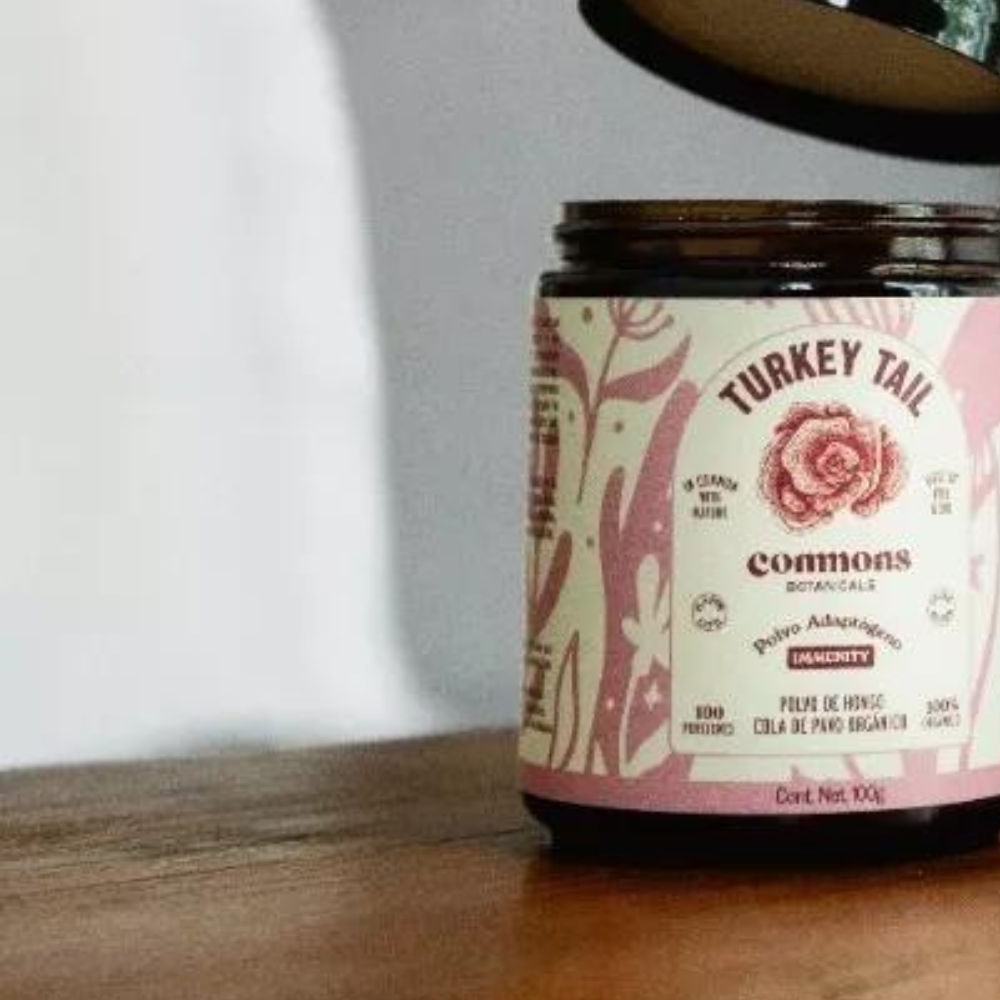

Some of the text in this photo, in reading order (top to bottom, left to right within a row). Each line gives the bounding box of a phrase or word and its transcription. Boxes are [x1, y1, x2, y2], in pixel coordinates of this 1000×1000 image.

[718, 339, 933, 418] TURKEY TAIL
[747, 549, 912, 577] commons
[786, 579, 877, 592] BOTANICALS
[753, 622, 803, 655] Polvo
[793, 650, 870, 665] IMMUNITY
[823, 695, 839, 712] DE
[753, 716, 787, 735] COLA
[790, 716, 807, 735] DE
